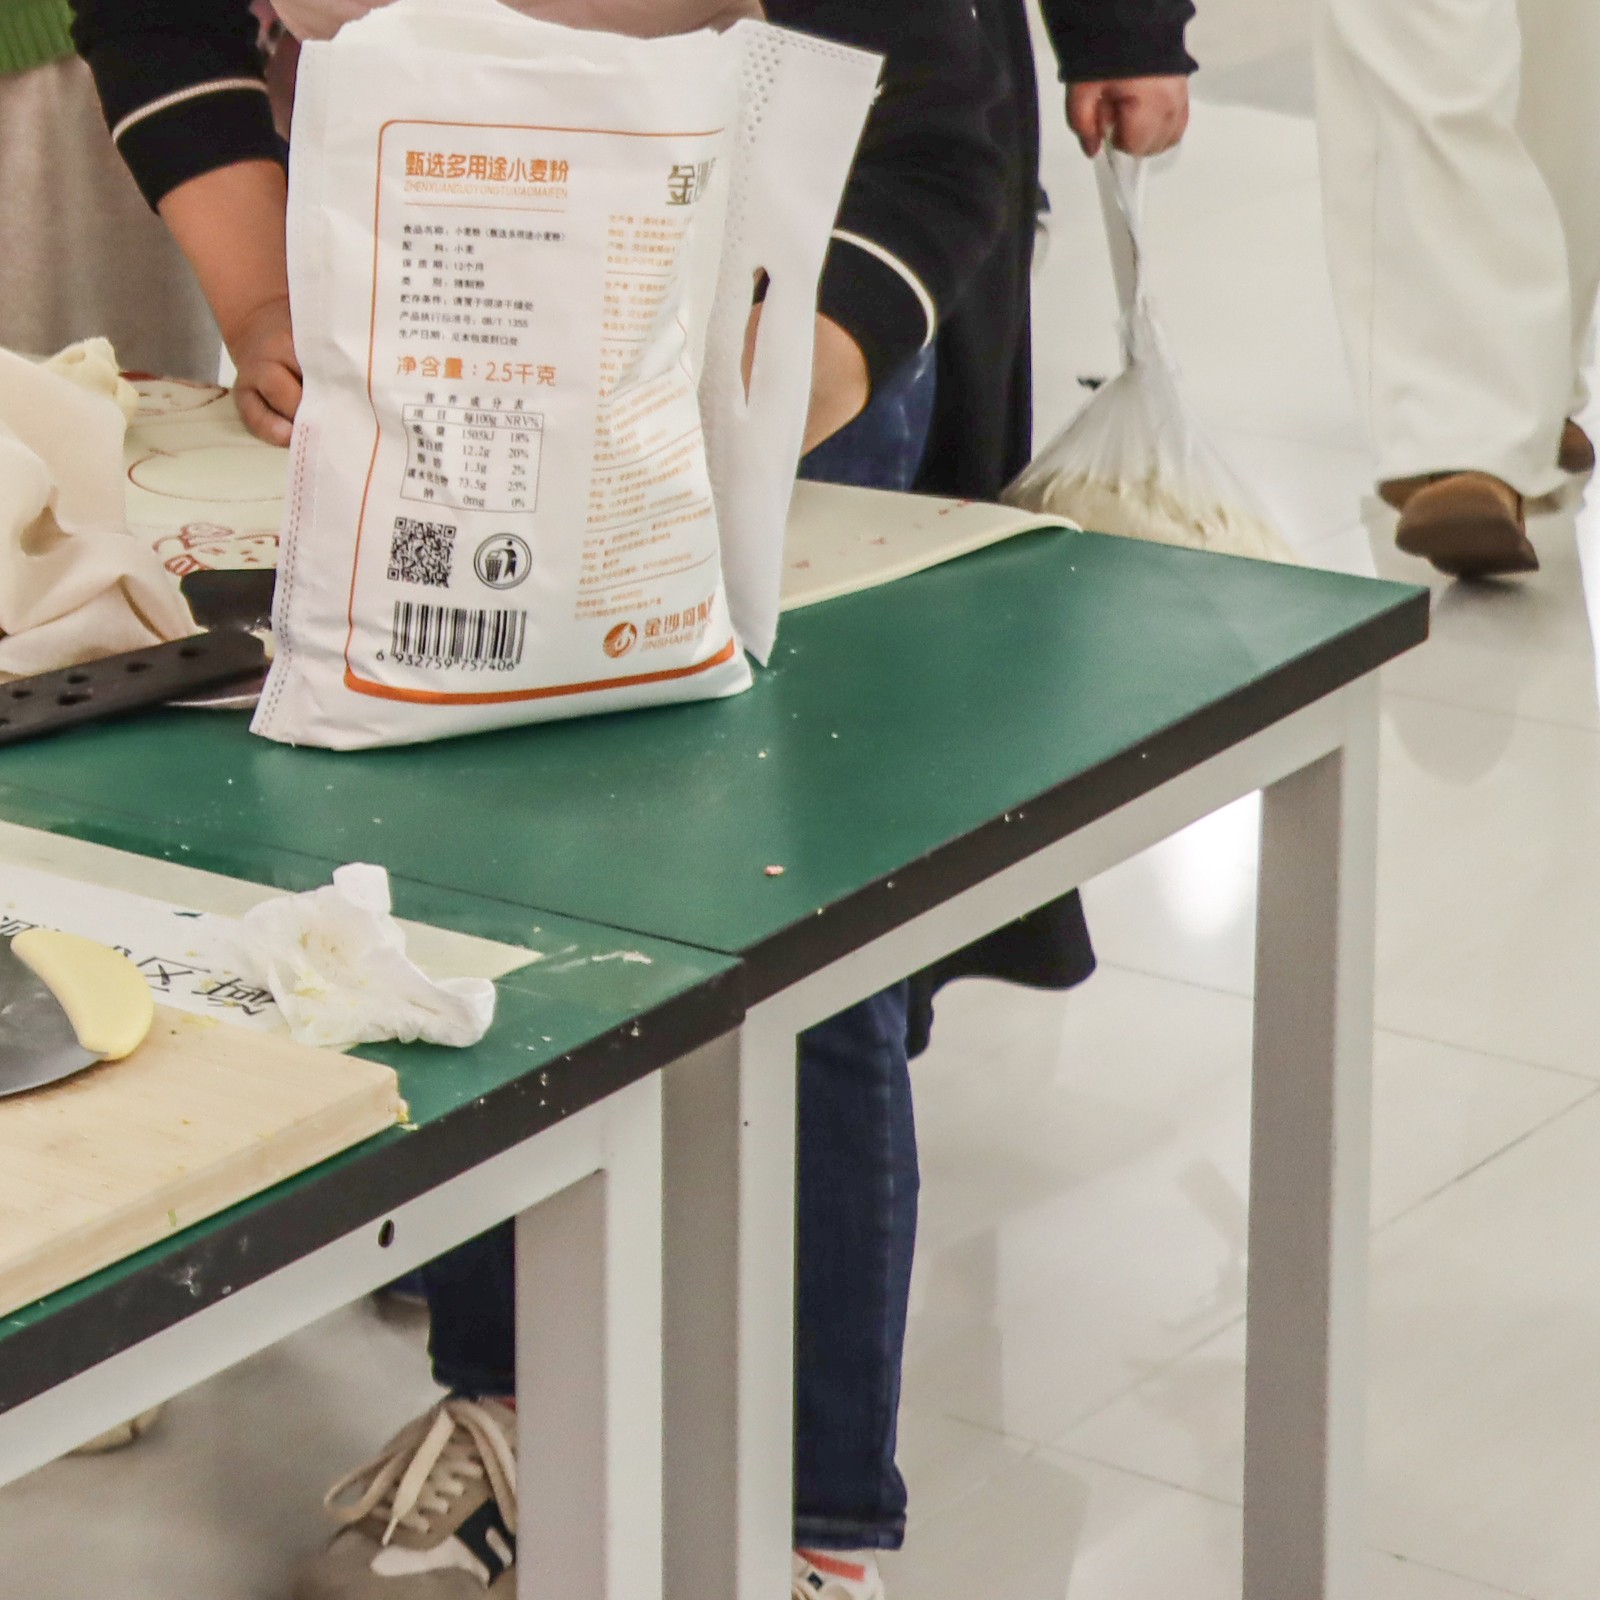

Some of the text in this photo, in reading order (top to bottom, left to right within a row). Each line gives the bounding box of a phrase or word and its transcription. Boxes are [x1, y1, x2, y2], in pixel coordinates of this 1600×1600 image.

[405, 150, 569, 183] 甄选多用途小麦粉
